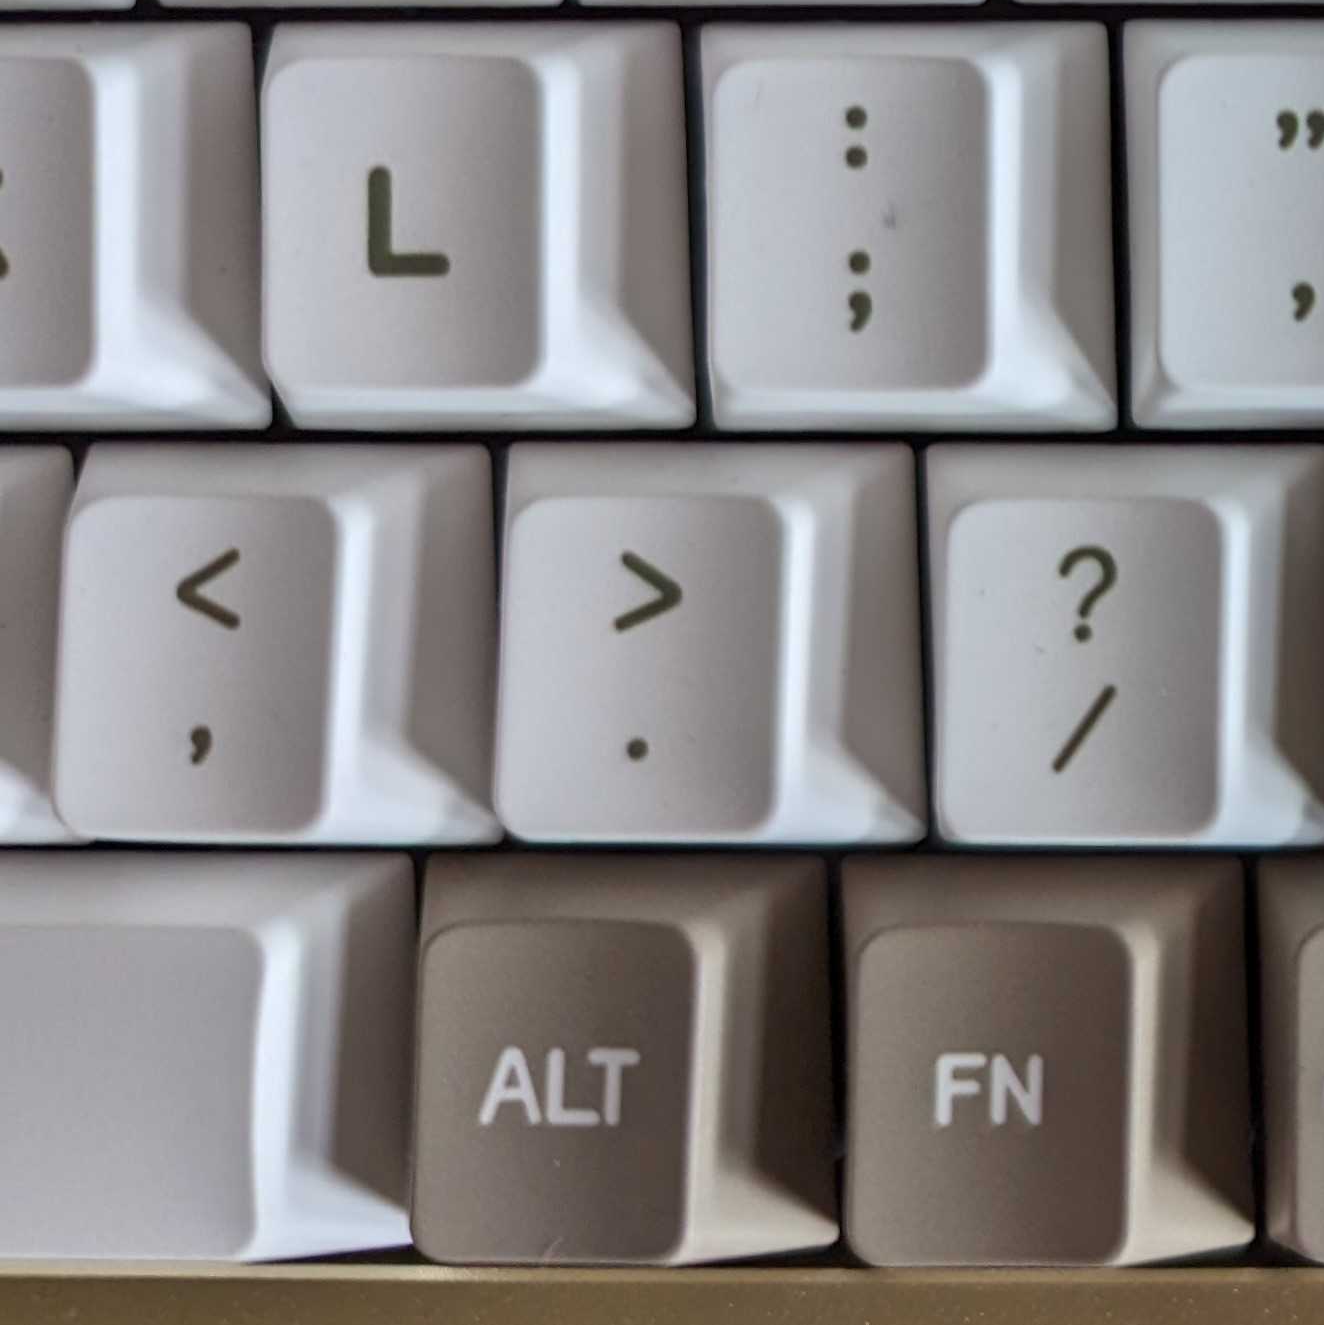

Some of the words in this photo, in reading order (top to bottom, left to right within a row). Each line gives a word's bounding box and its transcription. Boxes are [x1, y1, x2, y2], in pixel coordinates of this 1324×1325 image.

[366, 164, 451, 278] L
[1058, 544, 1118, 643] ?
[478, 1045, 641, 1128] ALT
[933, 1052, 1044, 1127] FN
